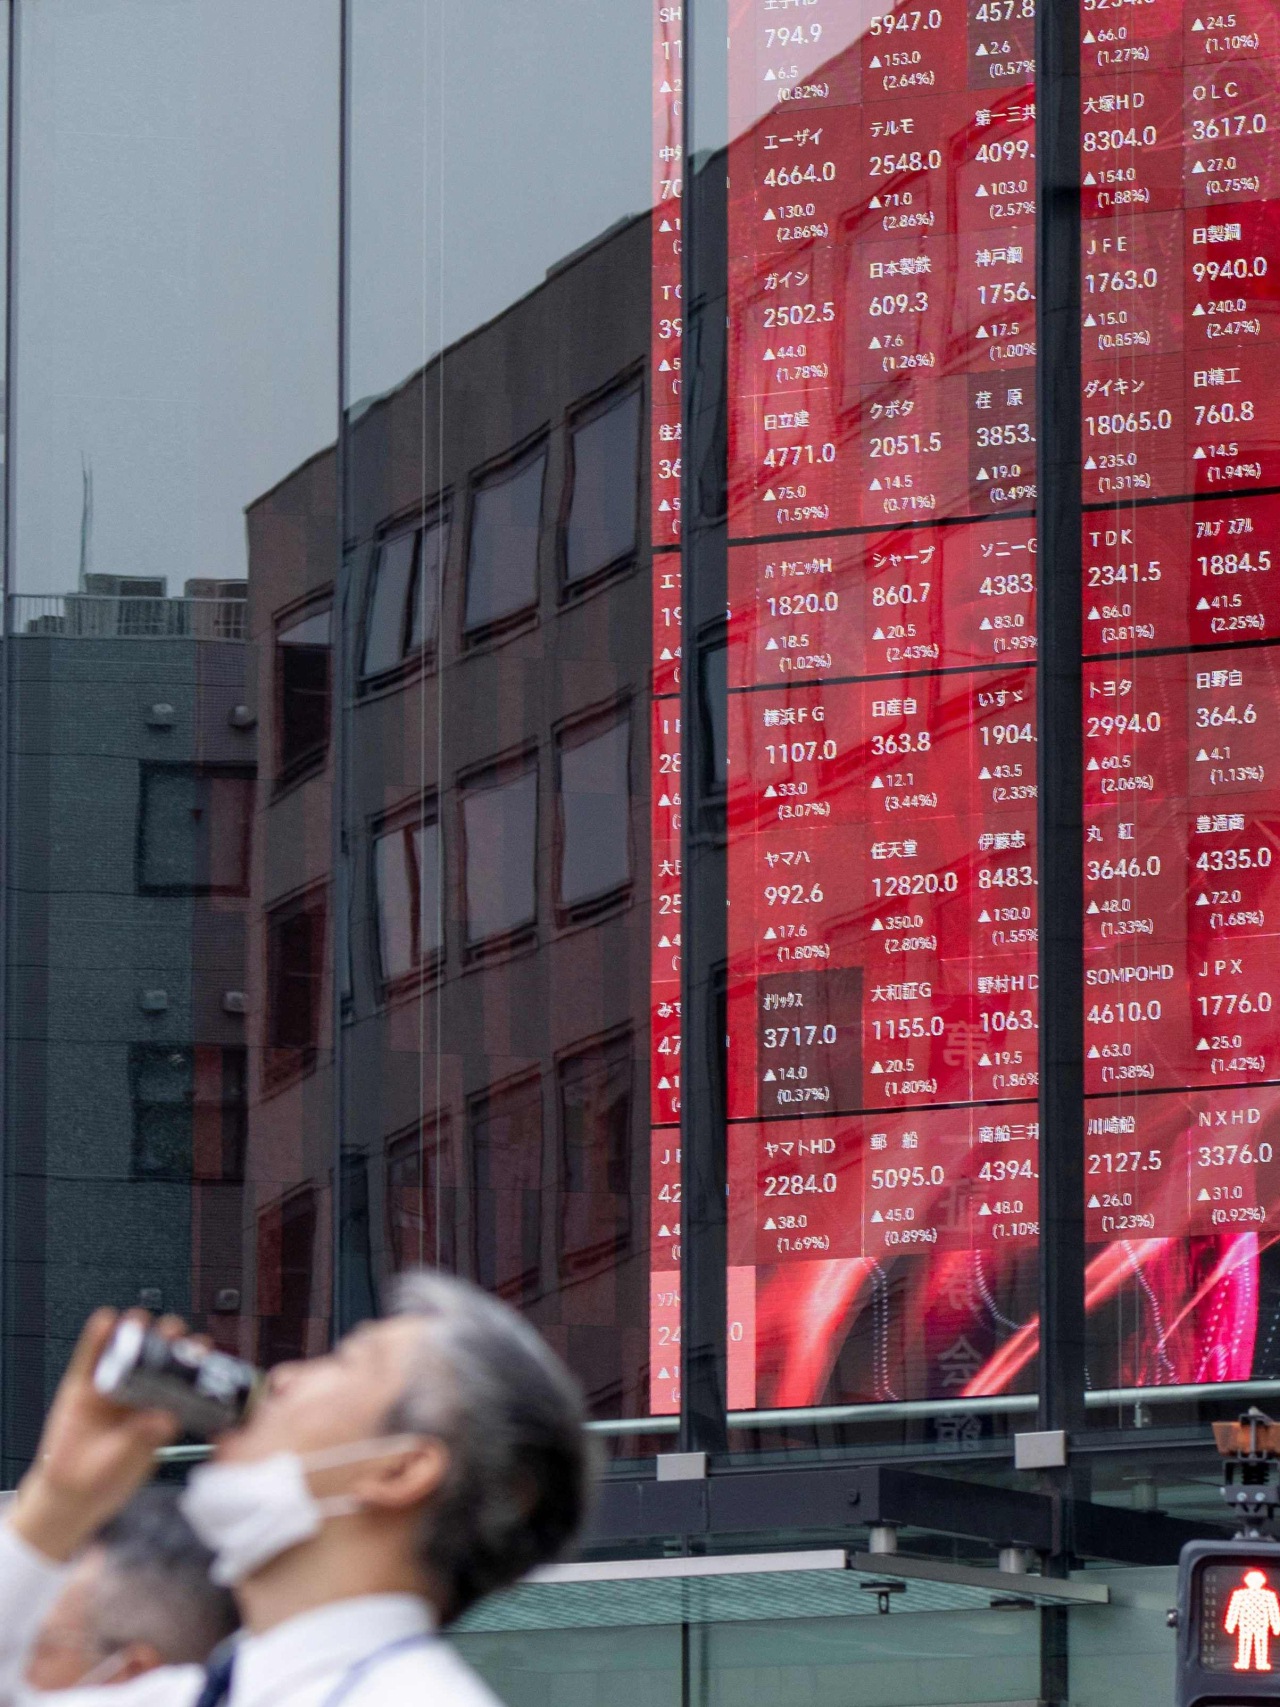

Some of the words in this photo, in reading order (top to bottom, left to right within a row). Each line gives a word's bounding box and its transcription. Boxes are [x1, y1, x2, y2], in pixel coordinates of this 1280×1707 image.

[870, 9, 942, 37] 5947.0
[765, 24, 821, 47] 794.9
[1206, 33, 1259, 53] (1.10%)
[870, 119, 913, 137] テルモ
[1192, 114, 1266, 140] 3617.0
[764, 128, 822, 149] エーザイ
[1083, 126, 1156, 151] 8304.0
[870, 150, 941, 175] 2548.0
[764, 162, 835, 187] 4664.0
[1206, 176, 1259, 195] (0.75%)
[883, 212, 934, 230] (2.86%)
[870, 256, 931, 278] 日本製鉄
[1193, 257, 1267, 282] 9940.0
[765, 272, 808, 289] ガイシ
[1086, 268, 1157, 293] 1763.0
[764, 302, 834, 327] 2502.5
[869, 292, 928, 316] 609.3
[1207, 319, 1260, 338] (2.47%)
[883, 352, 934, 371] (1.26%)
[777, 363, 828, 383] (1.78%)
[1084, 378, 1144, 398] ダイキン
[765, 410, 809, 430] 日立建
[870, 400, 914, 419] クボタ
[1195, 401, 1254, 425] 760.8
[1085, 410, 1171, 435] 18065.0
[764, 443, 835, 467] 4771.0
[870, 432, 941, 457] 2051.5
[873, 546, 935, 567] シャープ
[1198, 551, 1270, 575] 1884.5
[1089, 561, 1161, 586] 2341.5
[767, 592, 838, 616] 1820.0
[873, 583, 930, 606] 860.7
[1211, 614, 1264, 633] (2.25%)
[779, 654, 831, 672] (1.02%)
[886, 644, 938, 662] (2.43%)
[1091, 679, 1132, 697] トヨタ
[1197, 670, 1242, 689] 日野自
[764, 707, 824, 726] 横浜FG
[872, 698, 916, 717] 日産自
[1196, 704, 1256, 727] 364.6
[1087, 712, 1160, 737] 2994.0
[765, 740, 836, 764] 1107.0
[872, 732, 930, 754] 363.8
[1102, 775, 1153, 794] (2.06%)
[871, 840, 917, 859] 任天堂
[979, 830, 1025, 849] 伊藤忠
[765, 851, 810, 867] ヤマハ
[1087, 856, 1160, 880] 3646.0
[1196, 847, 1271, 871] 4335.0
[765, 883, 823, 905] 992.6
[872, 872, 957, 897] 12820.0
[1210, 910, 1264, 929] (1.68%)
[778, 944, 829, 962] (1.80%)
[1087, 965, 1173, 985] SOMPOHD
[871, 982, 931, 1001] 大和証G
[1087, 1000, 1161, 1024] 4610.0
[1198, 992, 1271, 1015] 1776.0
[764, 1025, 836, 1048] 3717.0
[872, 1017, 944, 1039] 1155.0
[777, 1087, 829, 1104] (0.37%)
[885, 1079, 937, 1096] (1.80%)
[765, 1138, 835, 1157] ヤマトHD
[1198, 1143, 1272, 1166] 3376.0
[1089, 1150, 1161, 1174] 2127.5
[764, 1173, 836, 1196] 2284.0
[872, 1166, 944, 1189] 5095.0
[1103, 1213, 1154, 1232] (1.23%)
[777, 1235, 829, 1253] (1.69%)
[885, 1228, 937, 1246] (0.89%)
